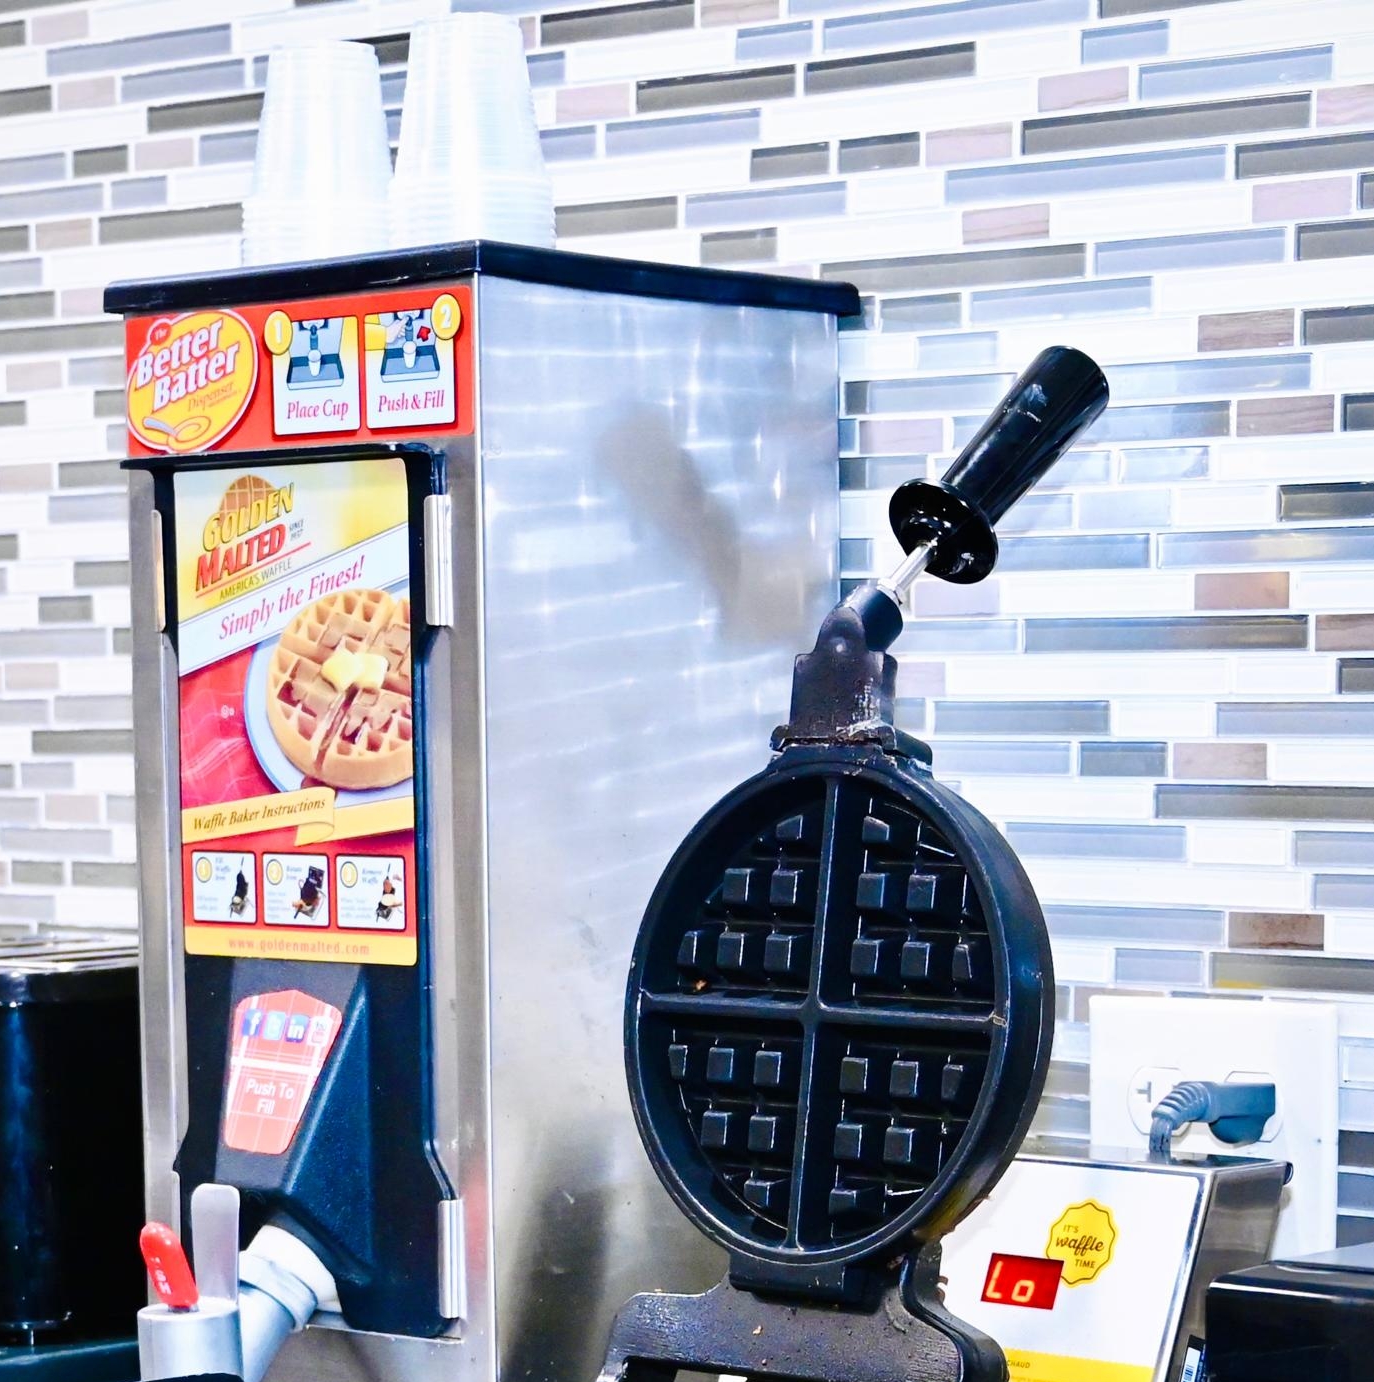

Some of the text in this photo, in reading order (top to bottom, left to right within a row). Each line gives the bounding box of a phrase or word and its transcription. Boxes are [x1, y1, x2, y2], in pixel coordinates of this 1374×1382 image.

[440, 304, 452, 329] 2
[276, 320, 282, 343] 1
[136, 317, 223, 390] Better
[153, 341, 240, 413] Batter
[188, 382, 234, 412] Dispenser
[287, 398, 349, 420] Place Cup
[378, 389, 445, 412] Push & Fill
[203, 482, 295, 552] GOLDEN
[195, 523, 286, 592] MALTED
[219, 559, 293, 601] AMERICA'S WAFFLE
[219, 554, 365, 640] Simply the Finest!
[193, 798, 326, 832] Waffle Baker Instructions
[246, 1078, 295, 1100] Push To
[257, 1098, 274, 1115] Fill
[1063, 1225, 1079, 1233] IT'S
[1056, 1235, 1104, 1257] waffle
[1075, 1259, 1096, 1269] TIME
